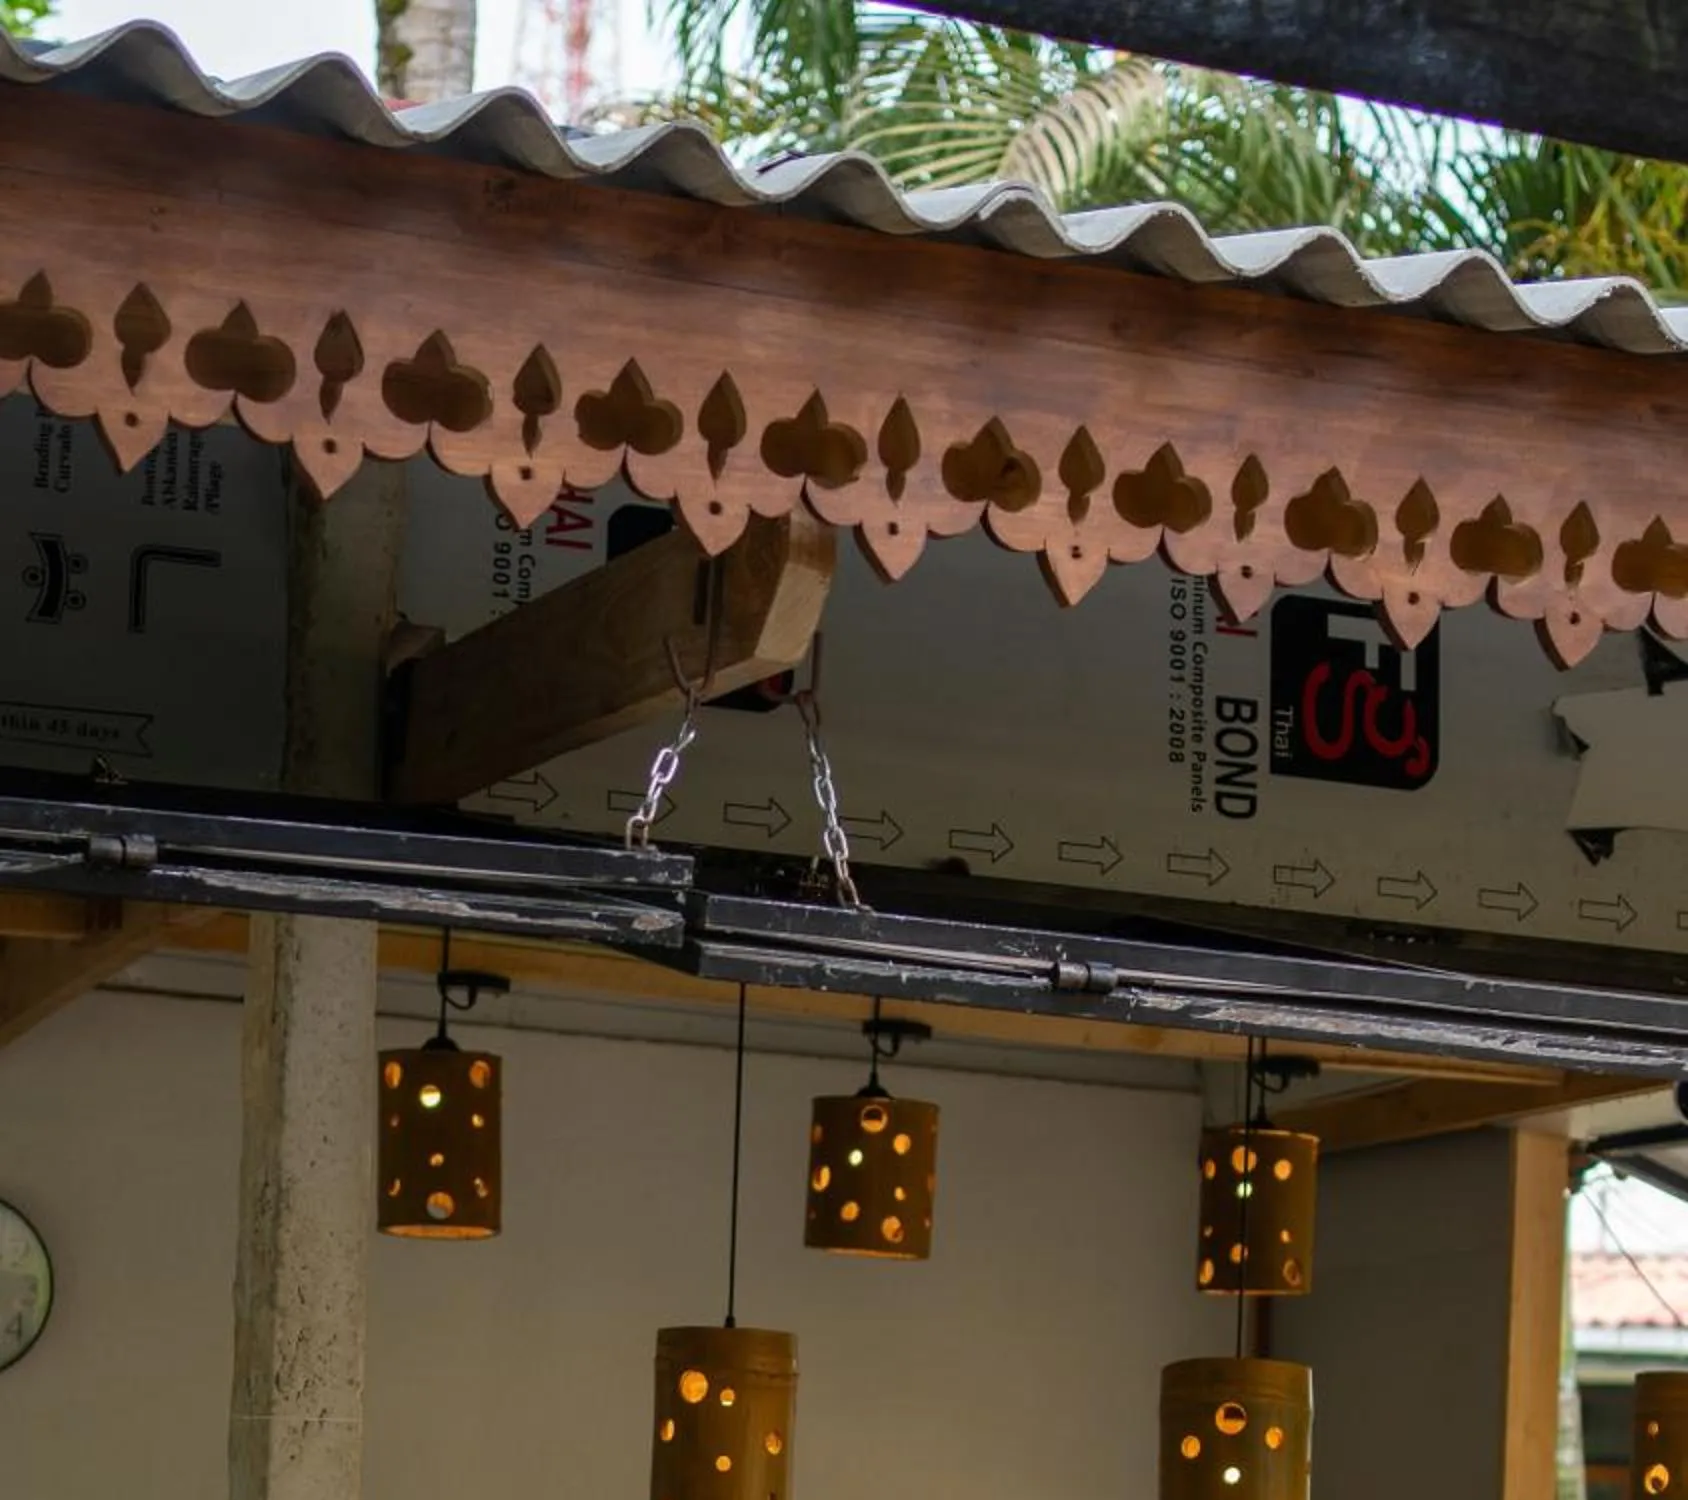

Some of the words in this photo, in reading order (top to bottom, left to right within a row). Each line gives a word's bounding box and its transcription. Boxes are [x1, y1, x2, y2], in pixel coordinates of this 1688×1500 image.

[33, 422, 54, 489] Bending
[546, 489, 594, 551] HAI
[492, 542, 513, 598] 9001
[1169, 578, 1187, 620] ISO
[1169, 629, 1186, 684] 9001
[1189, 641, 1209, 744] Composite
[1168, 707, 1186, 764] 2008
[1214, 695, 1259, 820] BOND
[1273, 705, 1294, 760] Thai
[1190, 750, 1208, 813] Panels
